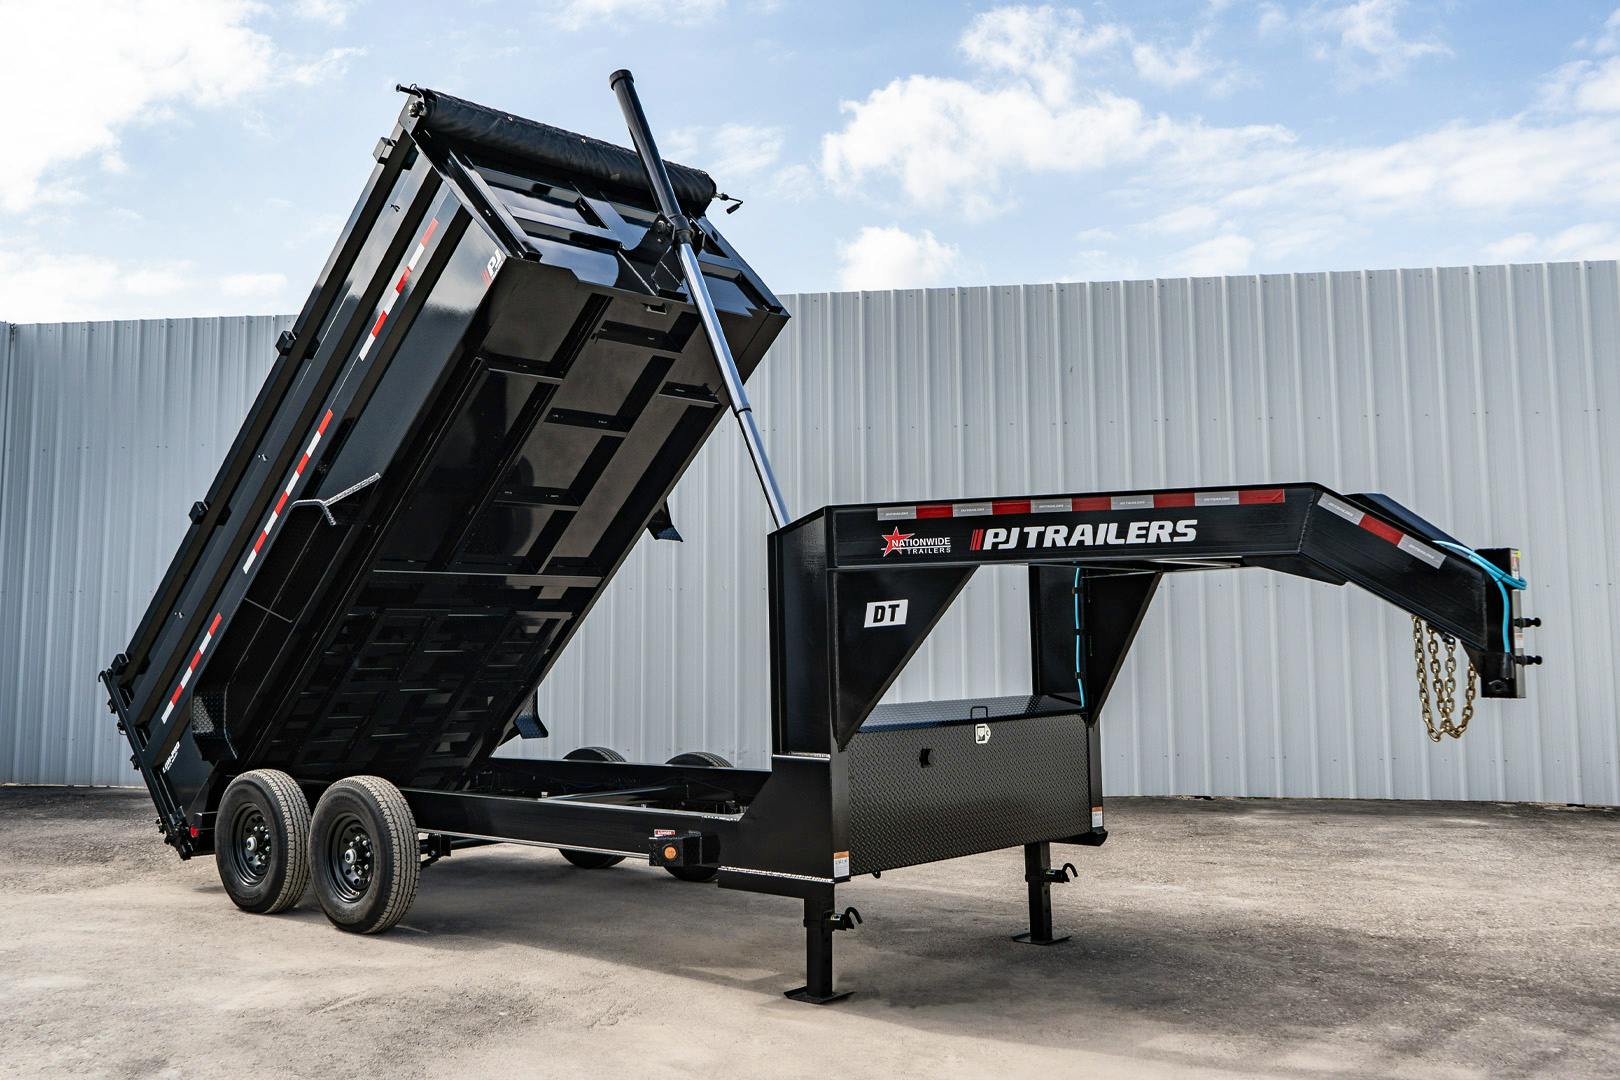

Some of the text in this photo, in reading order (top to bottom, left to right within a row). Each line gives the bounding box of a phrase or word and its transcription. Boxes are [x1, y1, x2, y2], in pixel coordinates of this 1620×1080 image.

[487, 249, 502, 278] PJ
[892, 537, 951, 547] NATIONWIDE
[983, 519, 1198, 550] PJ TRAILERS
[907, 547, 951, 555] TRAILERS
[873, 604, 900, 623] DT
